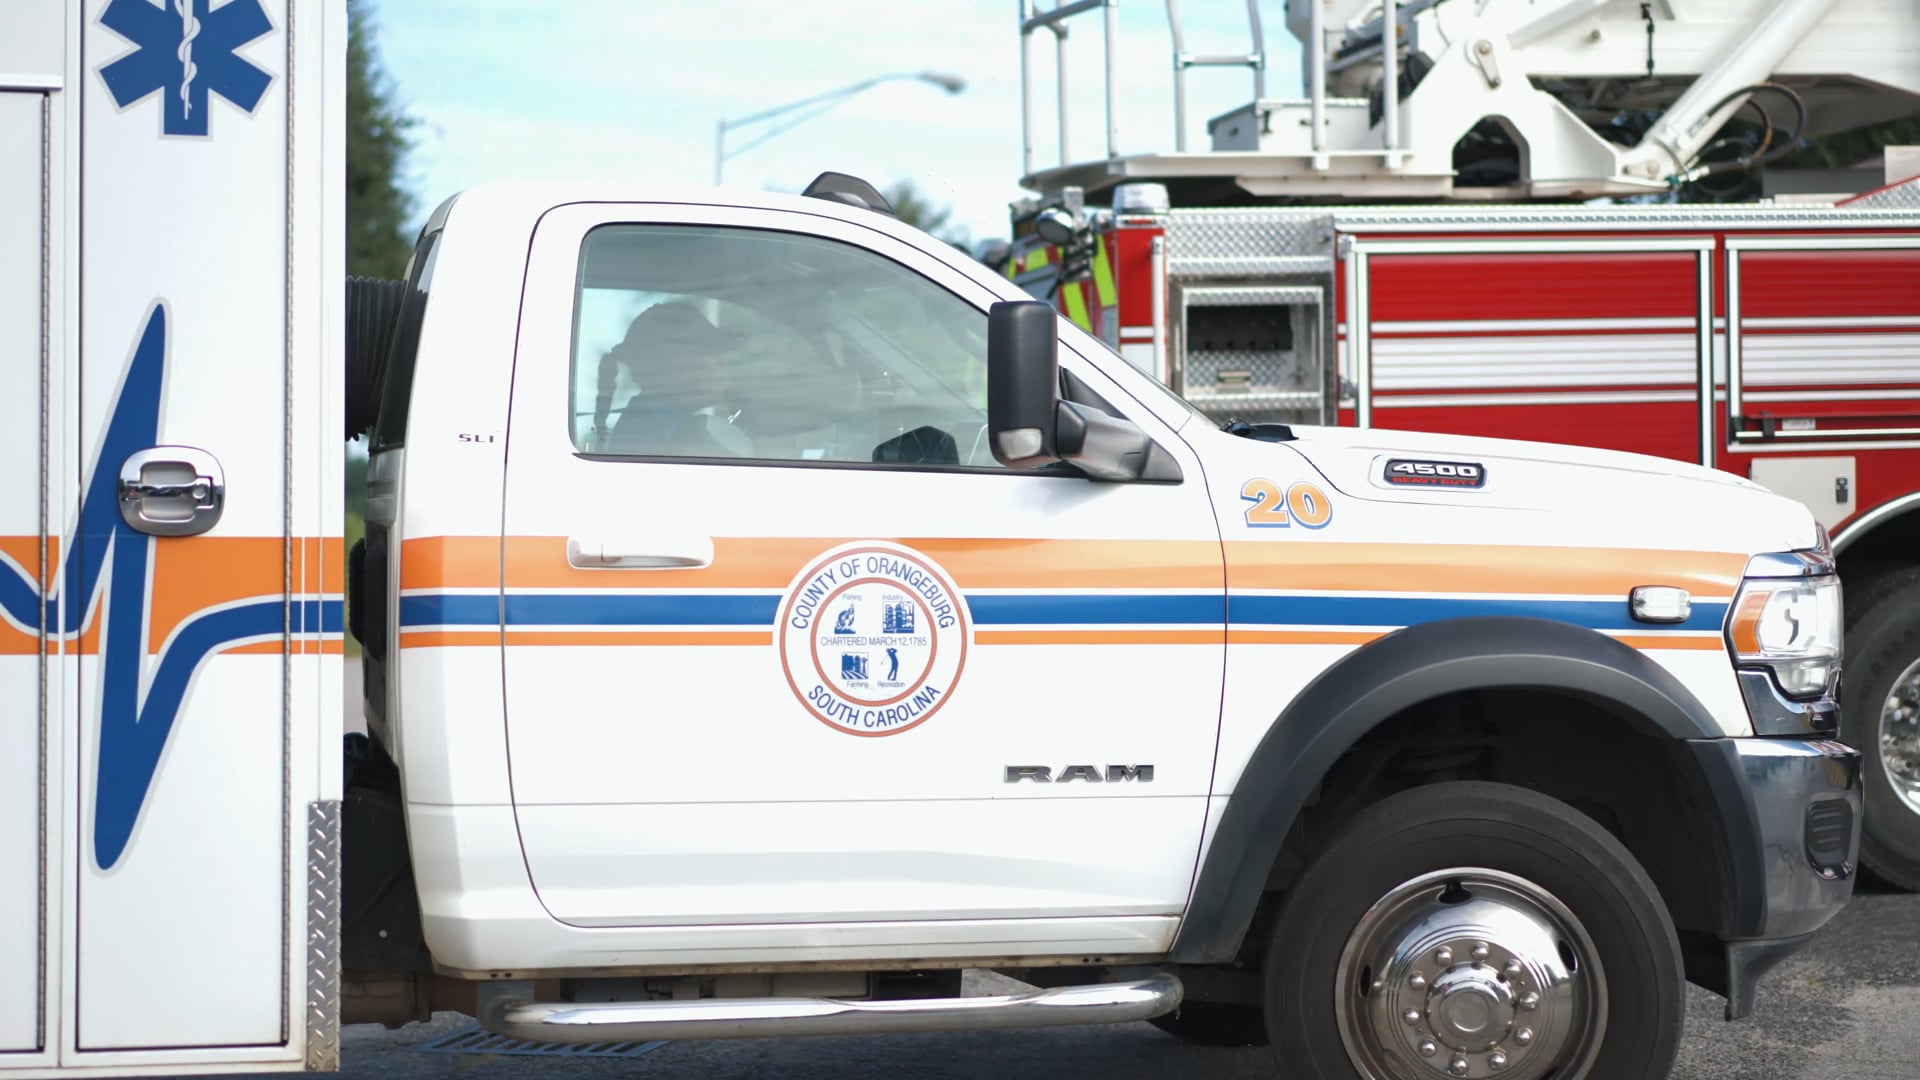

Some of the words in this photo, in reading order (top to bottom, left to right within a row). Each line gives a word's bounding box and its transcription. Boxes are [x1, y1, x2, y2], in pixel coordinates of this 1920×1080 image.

[1392, 463, 1478, 478] 4500
[1240, 477, 1333, 530] 20
[792, 569, 837, 629] COUNTY
[840, 558, 861, 578] OF
[867, 556, 955, 629] ORANGEBURG
[820, 637, 867, 646] CHARTERED
[868, 637, 897, 646] MARCH
[808, 685, 860, 726] SOUTH
[863, 685, 941, 728] CAROLINA
[1004, 763, 1155, 783] RAM
